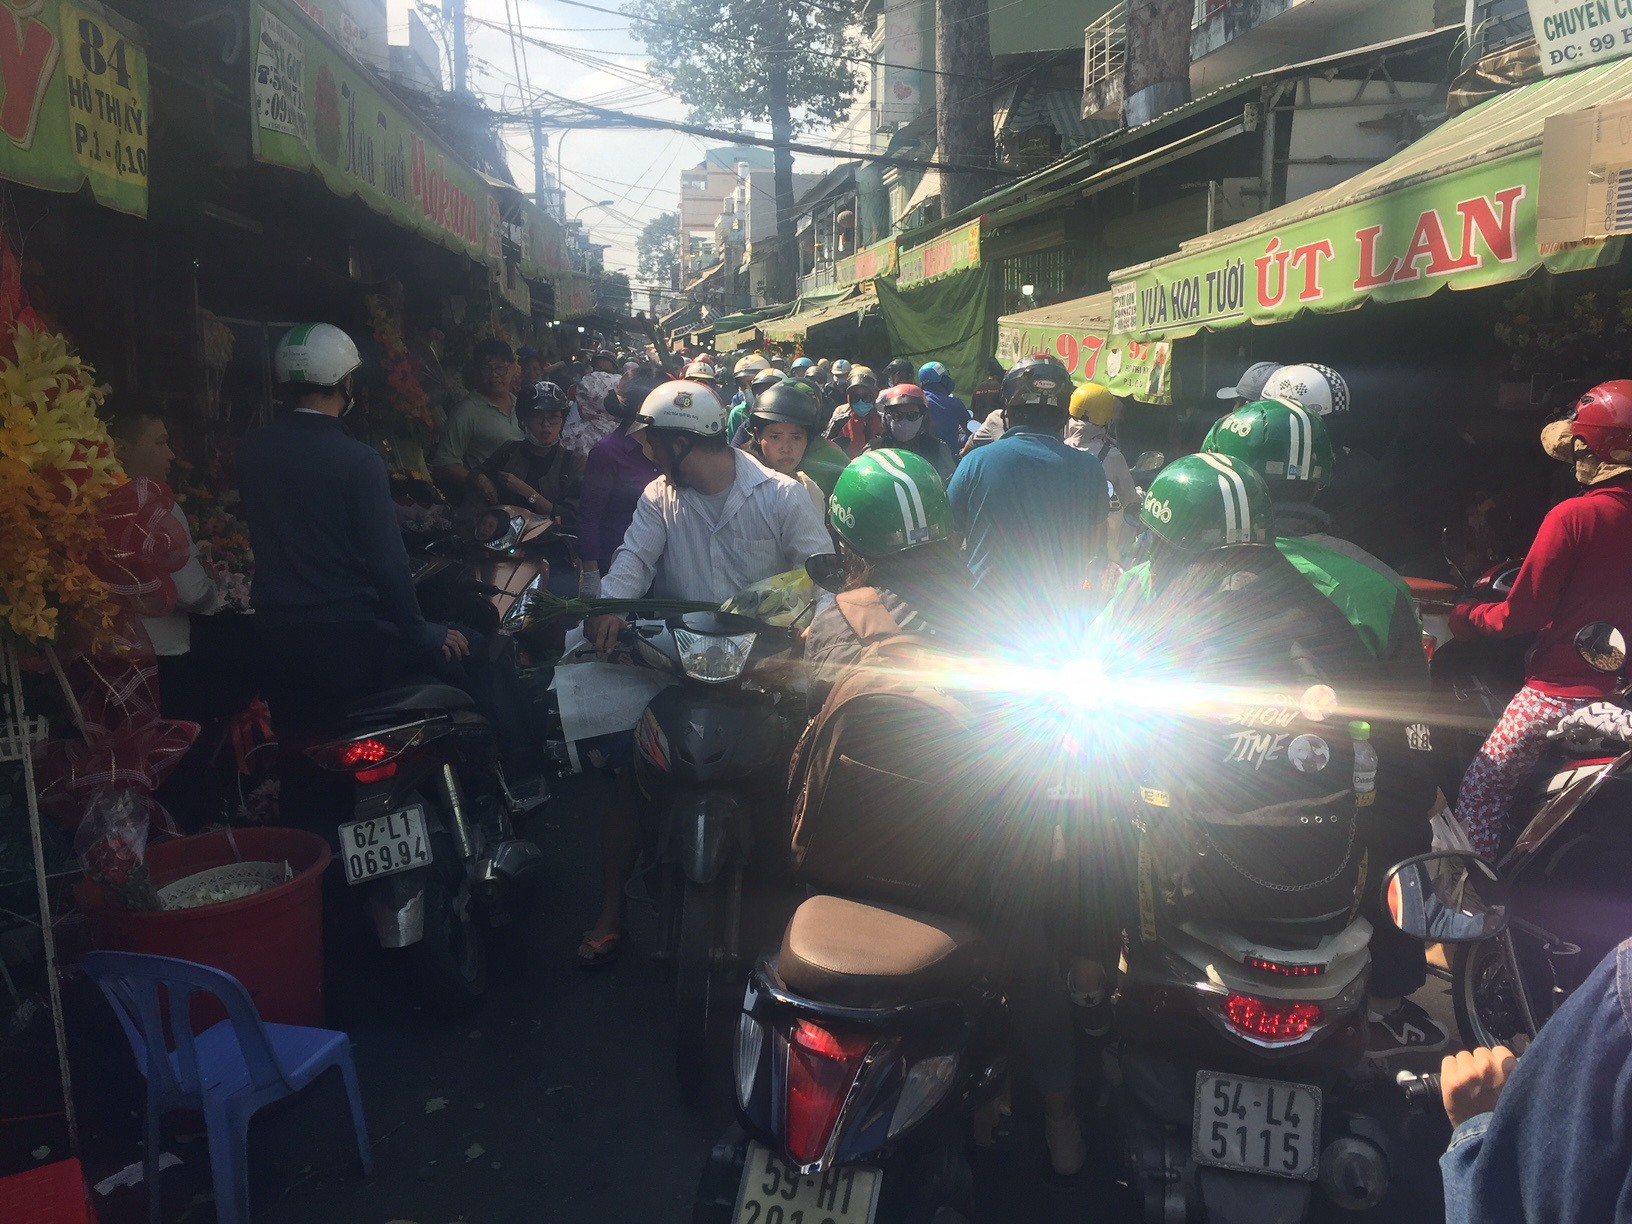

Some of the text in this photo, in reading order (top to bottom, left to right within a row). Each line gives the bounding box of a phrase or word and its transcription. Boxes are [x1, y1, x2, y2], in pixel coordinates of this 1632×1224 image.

[78, 19, 131, 90] 84
[1549, 45, 1583, 65] ĐC:
[1590, 34, 1615, 53] 99
[1171, 276, 1200, 321] HOA
[1206, 256, 1245, 314] TƯƠI
[1254, 236, 1335, 310] ÚT
[1353, 185, 1526, 291] LAN
[1056, 333, 1106, 380] 97
[1129, 341, 1151, 361] 97
[1144, 491, 1173, 523] Grab
[1222, 729, 1290, 771] TIME
[353, 811, 411, 849] 62-L1
[350, 836, 426, 879] 069.94
[1213, 1080, 1300, 1128] 54-L4
[1211, 1120, 1300, 1170] 5115
